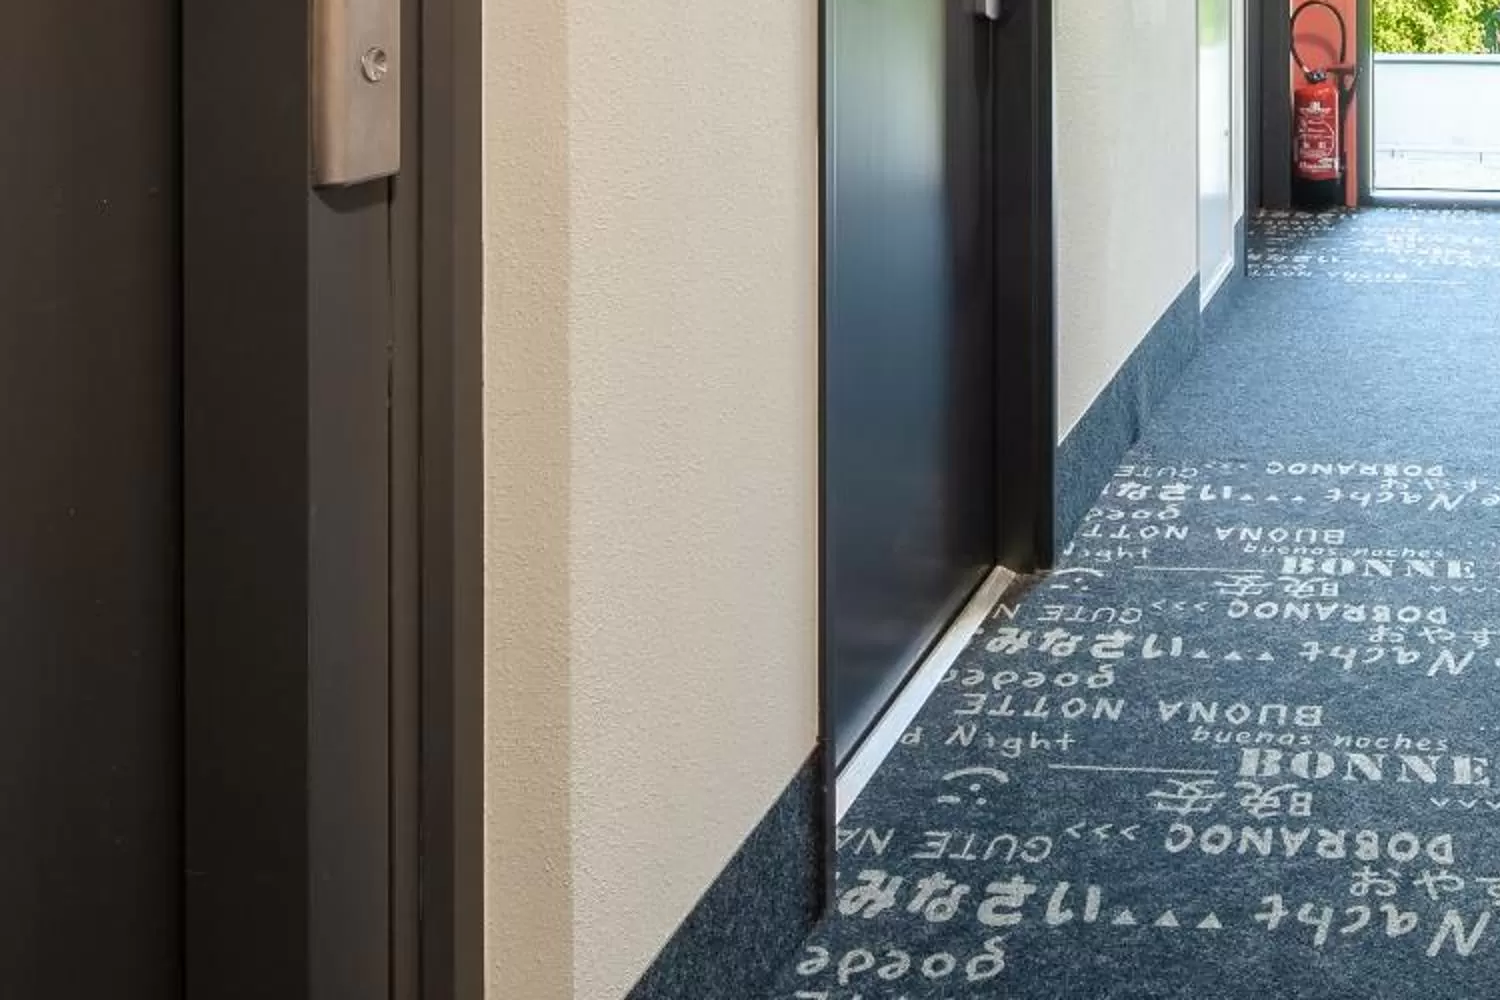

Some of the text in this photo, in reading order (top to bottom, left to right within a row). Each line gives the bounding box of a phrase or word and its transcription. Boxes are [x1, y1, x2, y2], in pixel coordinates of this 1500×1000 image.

[1215, 526, 1345, 545] BUONA
[1281, 556, 1476, 580] BONNE
[1227, 600, 1447, 625] DOBRANOC
[1299, 641, 1476, 677] Nacht
[953, 693, 1324, 727] BUONA NOTTE
[944, 721, 1076, 758] Night
[1333, 733, 1451, 752] noches
[1238, 747, 1492, 787] BONNE
[908, 830, 1053, 863] GUTE
[1164, 823, 1455, 865] DOBRANOC
[1253, 892, 1492, 957] Nacht
